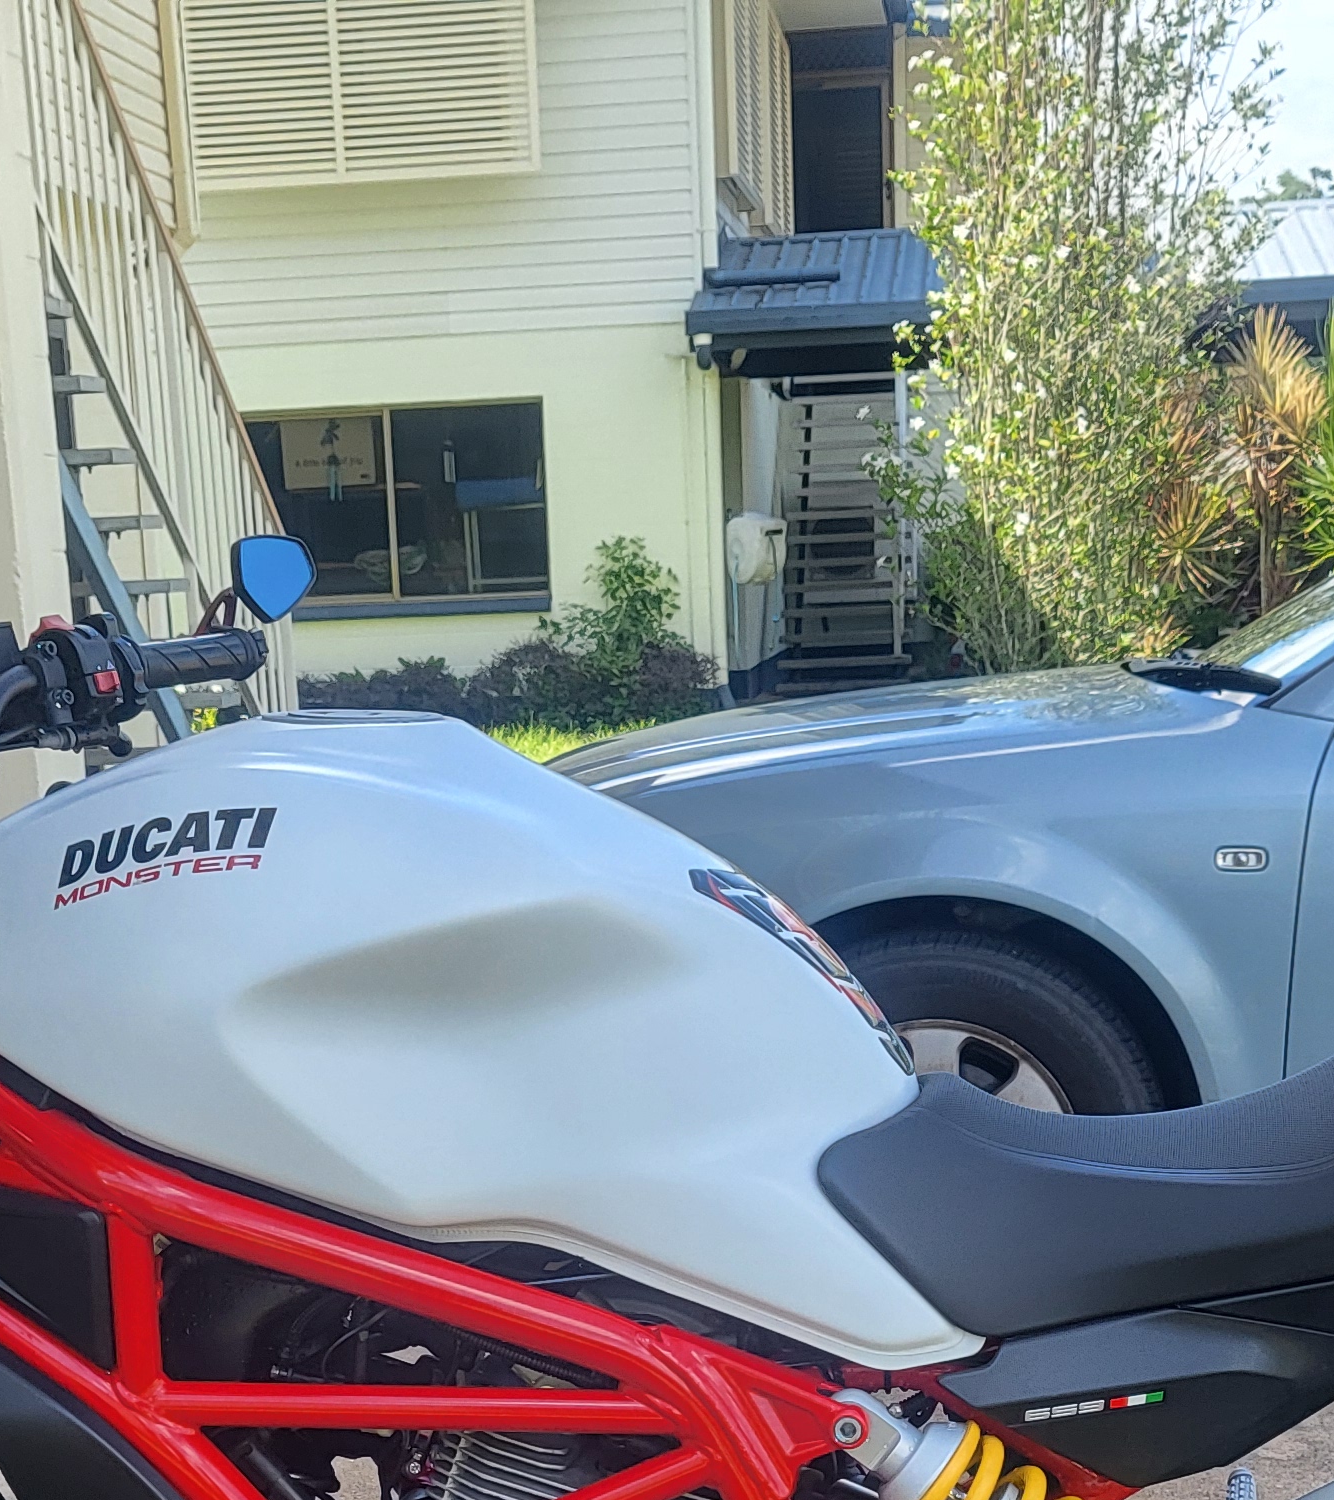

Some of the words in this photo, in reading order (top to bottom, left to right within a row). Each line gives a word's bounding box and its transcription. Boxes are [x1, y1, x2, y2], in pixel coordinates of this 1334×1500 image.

[58, 807, 277, 889] DUCATI
[54, 854, 262, 910] MONSTER
[1025, 1399, 1105, 1422] 659
